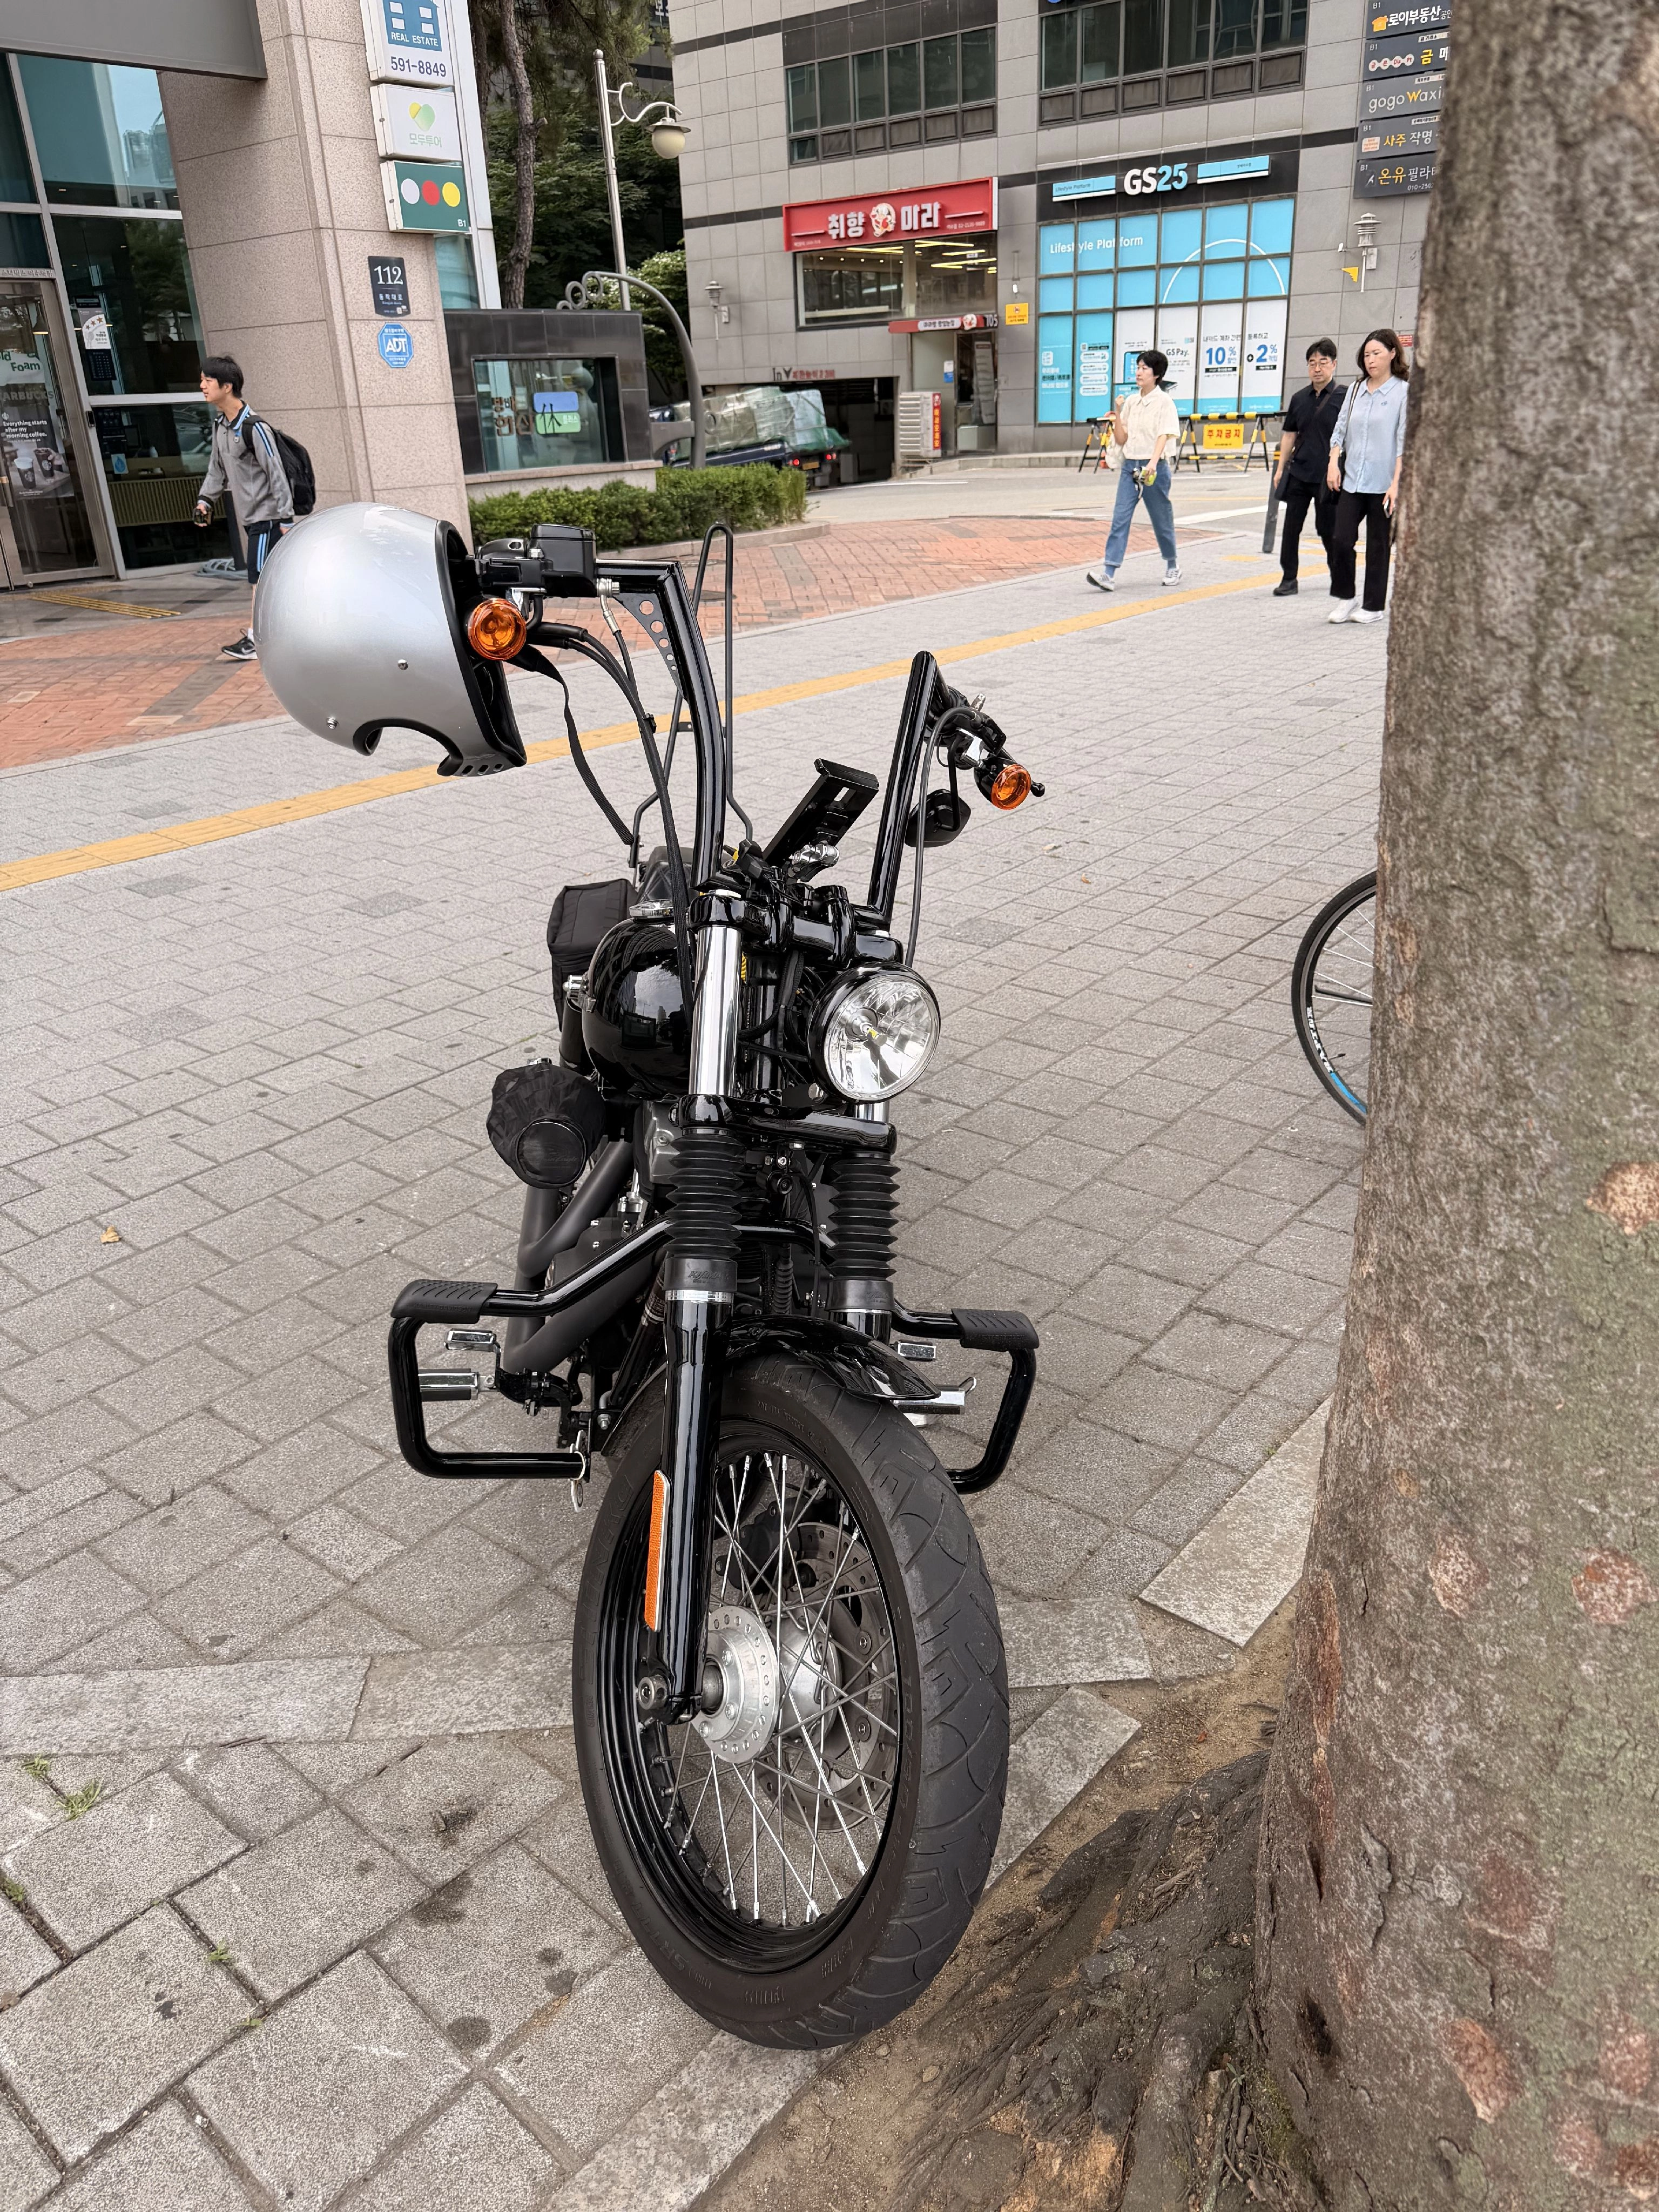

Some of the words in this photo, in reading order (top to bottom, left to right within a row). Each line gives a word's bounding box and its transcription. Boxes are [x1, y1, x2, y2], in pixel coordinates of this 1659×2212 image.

[1387, 5, 1441, 26] 로이부동산
[391, 31, 410, 43] REAL
[412, 35, 439, 47] ESTATE
[1420, 49, 1433, 65] 금
[390, 56, 447, 77] 591-8849
[409, 132, 442, 148] 모두투어
[1384, 133, 1406, 147] 사주
[1410, 130, 1433, 145] 작명
[1123, 163, 1188, 195] GS25
[1378, 167, 1406, 185] 온유
[457, 219, 467, 227] B1
[828, 211, 866, 239] 취향
[900, 202, 942, 231] 마라
[1050, 240, 1094, 254] Lifestyle
[1096, 236, 1143, 249] Platform
[374, 265, 403, 285] 112
[385, 338, 407, 353] ADT
[10, 362, 41, 372] Foam
[0, 391, 54, 401] ARBUCKS
